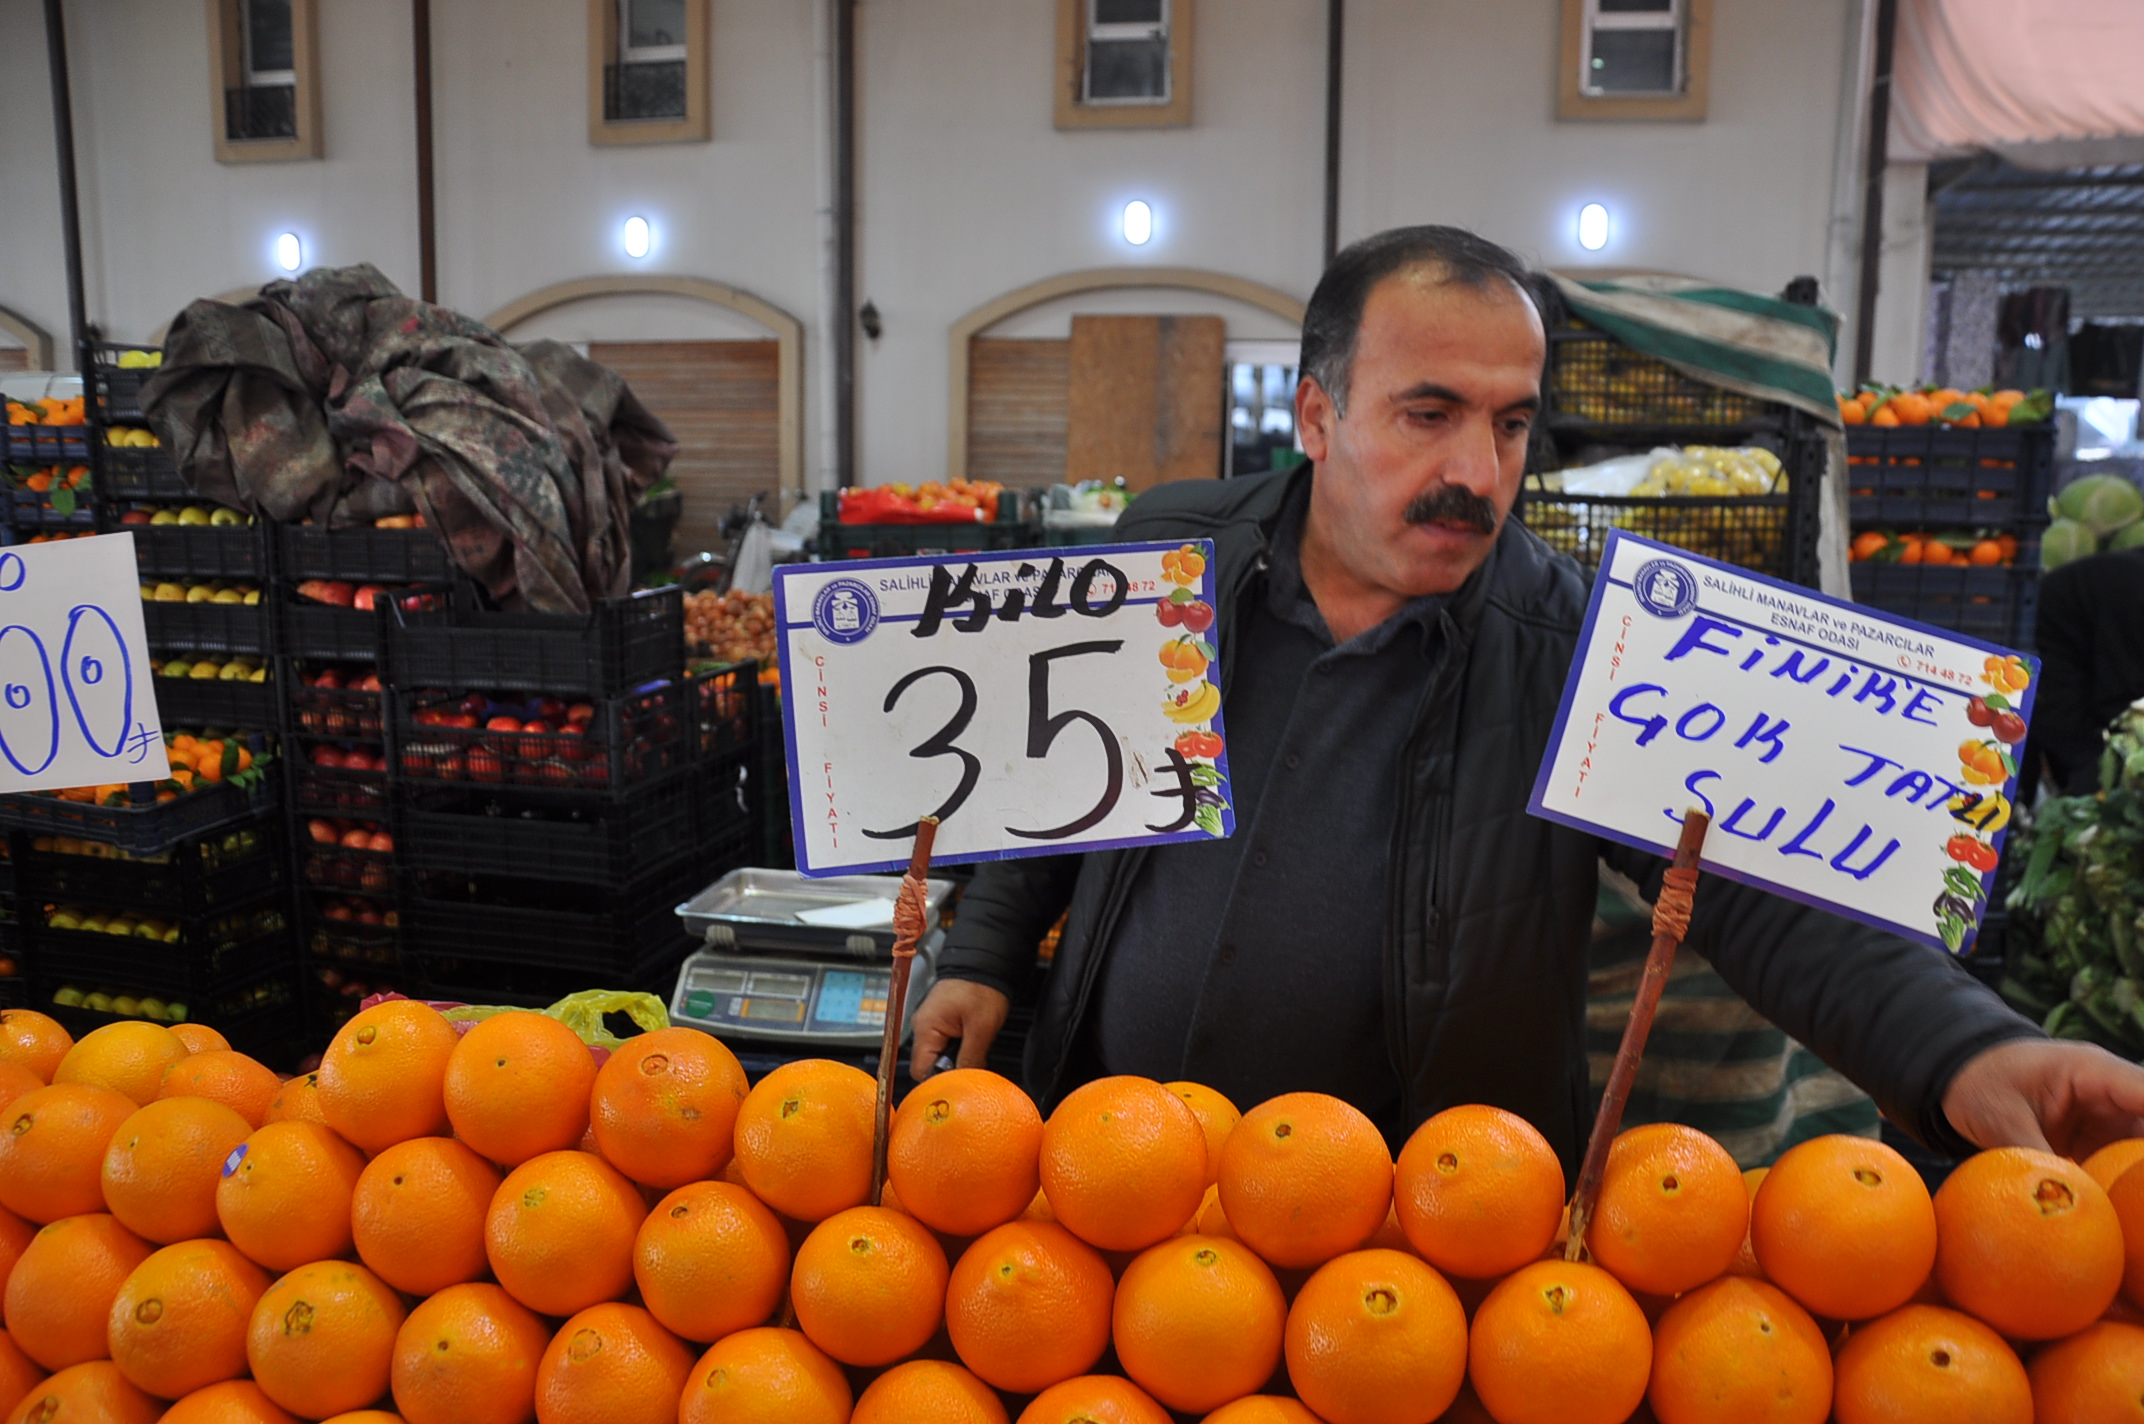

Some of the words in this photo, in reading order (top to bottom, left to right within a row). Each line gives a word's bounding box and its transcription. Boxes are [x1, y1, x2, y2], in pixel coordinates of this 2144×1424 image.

[1142, 580, 1156, 592] 72
[1756, 593, 1830, 626] MANAVLAR
[1833, 617, 1848, 631] ve
[1850, 621, 1936, 658] PAZARCILAR
[1770, 612, 1816, 636] ESNAF
[1817, 627, 1860, 652] ODASI
[1915, 659, 1938, 675] 714
[1940, 668, 1955, 681] 48
[1958, 673, 1974, 686] 72
[861, 640, 1124, 839] 35
[1662, 769, 1902, 881] SULU
